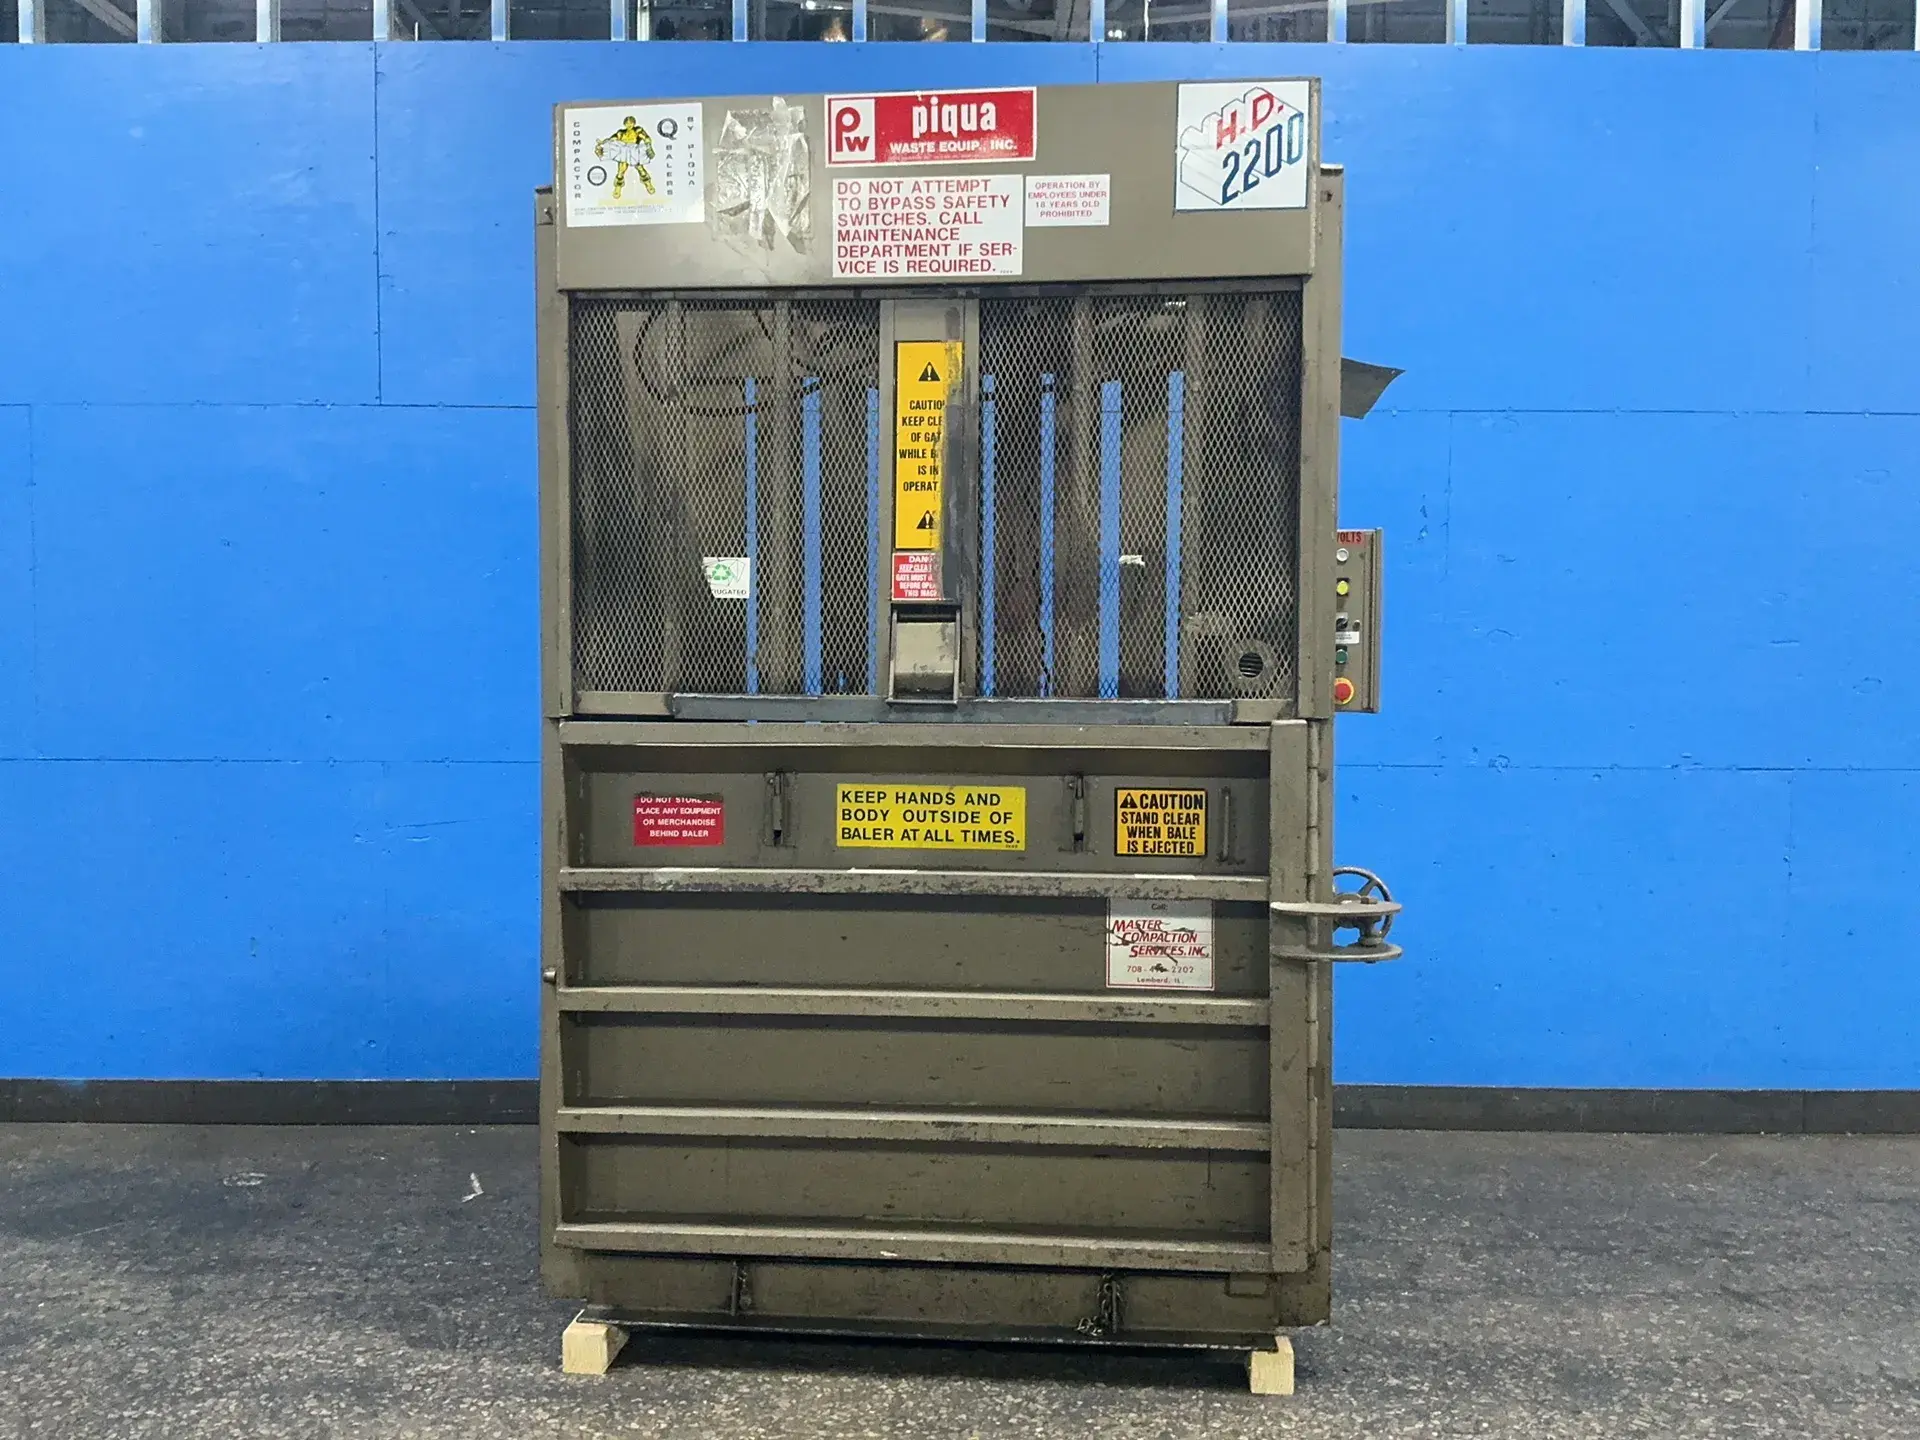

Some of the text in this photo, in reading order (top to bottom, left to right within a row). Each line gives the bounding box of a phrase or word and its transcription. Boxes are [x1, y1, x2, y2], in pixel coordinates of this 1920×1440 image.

[912, 96, 997, 138] piqua
[1216, 93, 1284, 150] H.D.
[890, 141, 936, 154] WASTE
[990, 138, 1018, 150] INC.
[572, 122, 582, 198] COMPACTOR
[1222, 112, 1304, 206] 2200
[666, 144, 674, 196] BALERS
[837, 179, 991, 195] DO NOT ATTEMPT
[1034, 182, 1086, 190] OPERATION
[838, 194, 1010, 211] TO BYPASS SAFETY
[838, 211, 983, 227] SWITCHES. CALL
[838, 228, 960, 242] MAINTENANCE
[838, 242, 1018, 258] DEPARTMENT IF SER-
[838, 258, 996, 274] VICE IS REQUIRED.
[902, 416, 925, 426] KEEP
[910, 432, 922, 442] OF
[899, 449, 927, 459] WHILE
[918, 466, 926, 475] IS
[842, 790, 1001, 806] KEEP HANDS AND
[1140, 793, 1204, 810] CAUTION
[842, 808, 1013, 825] BODY OUTSIDE OF
[1120, 811, 1200, 826] STAND CLEAR
[842, 827, 1020, 844] BALER AT ALL TIMES.
[1126, 826, 1196, 840] WHEN BALE
[1127, 840, 1194, 854] IS EJECTED
[1113, 920, 1162, 932] MASTER
[1122, 932, 1198, 944] COMPACTION
